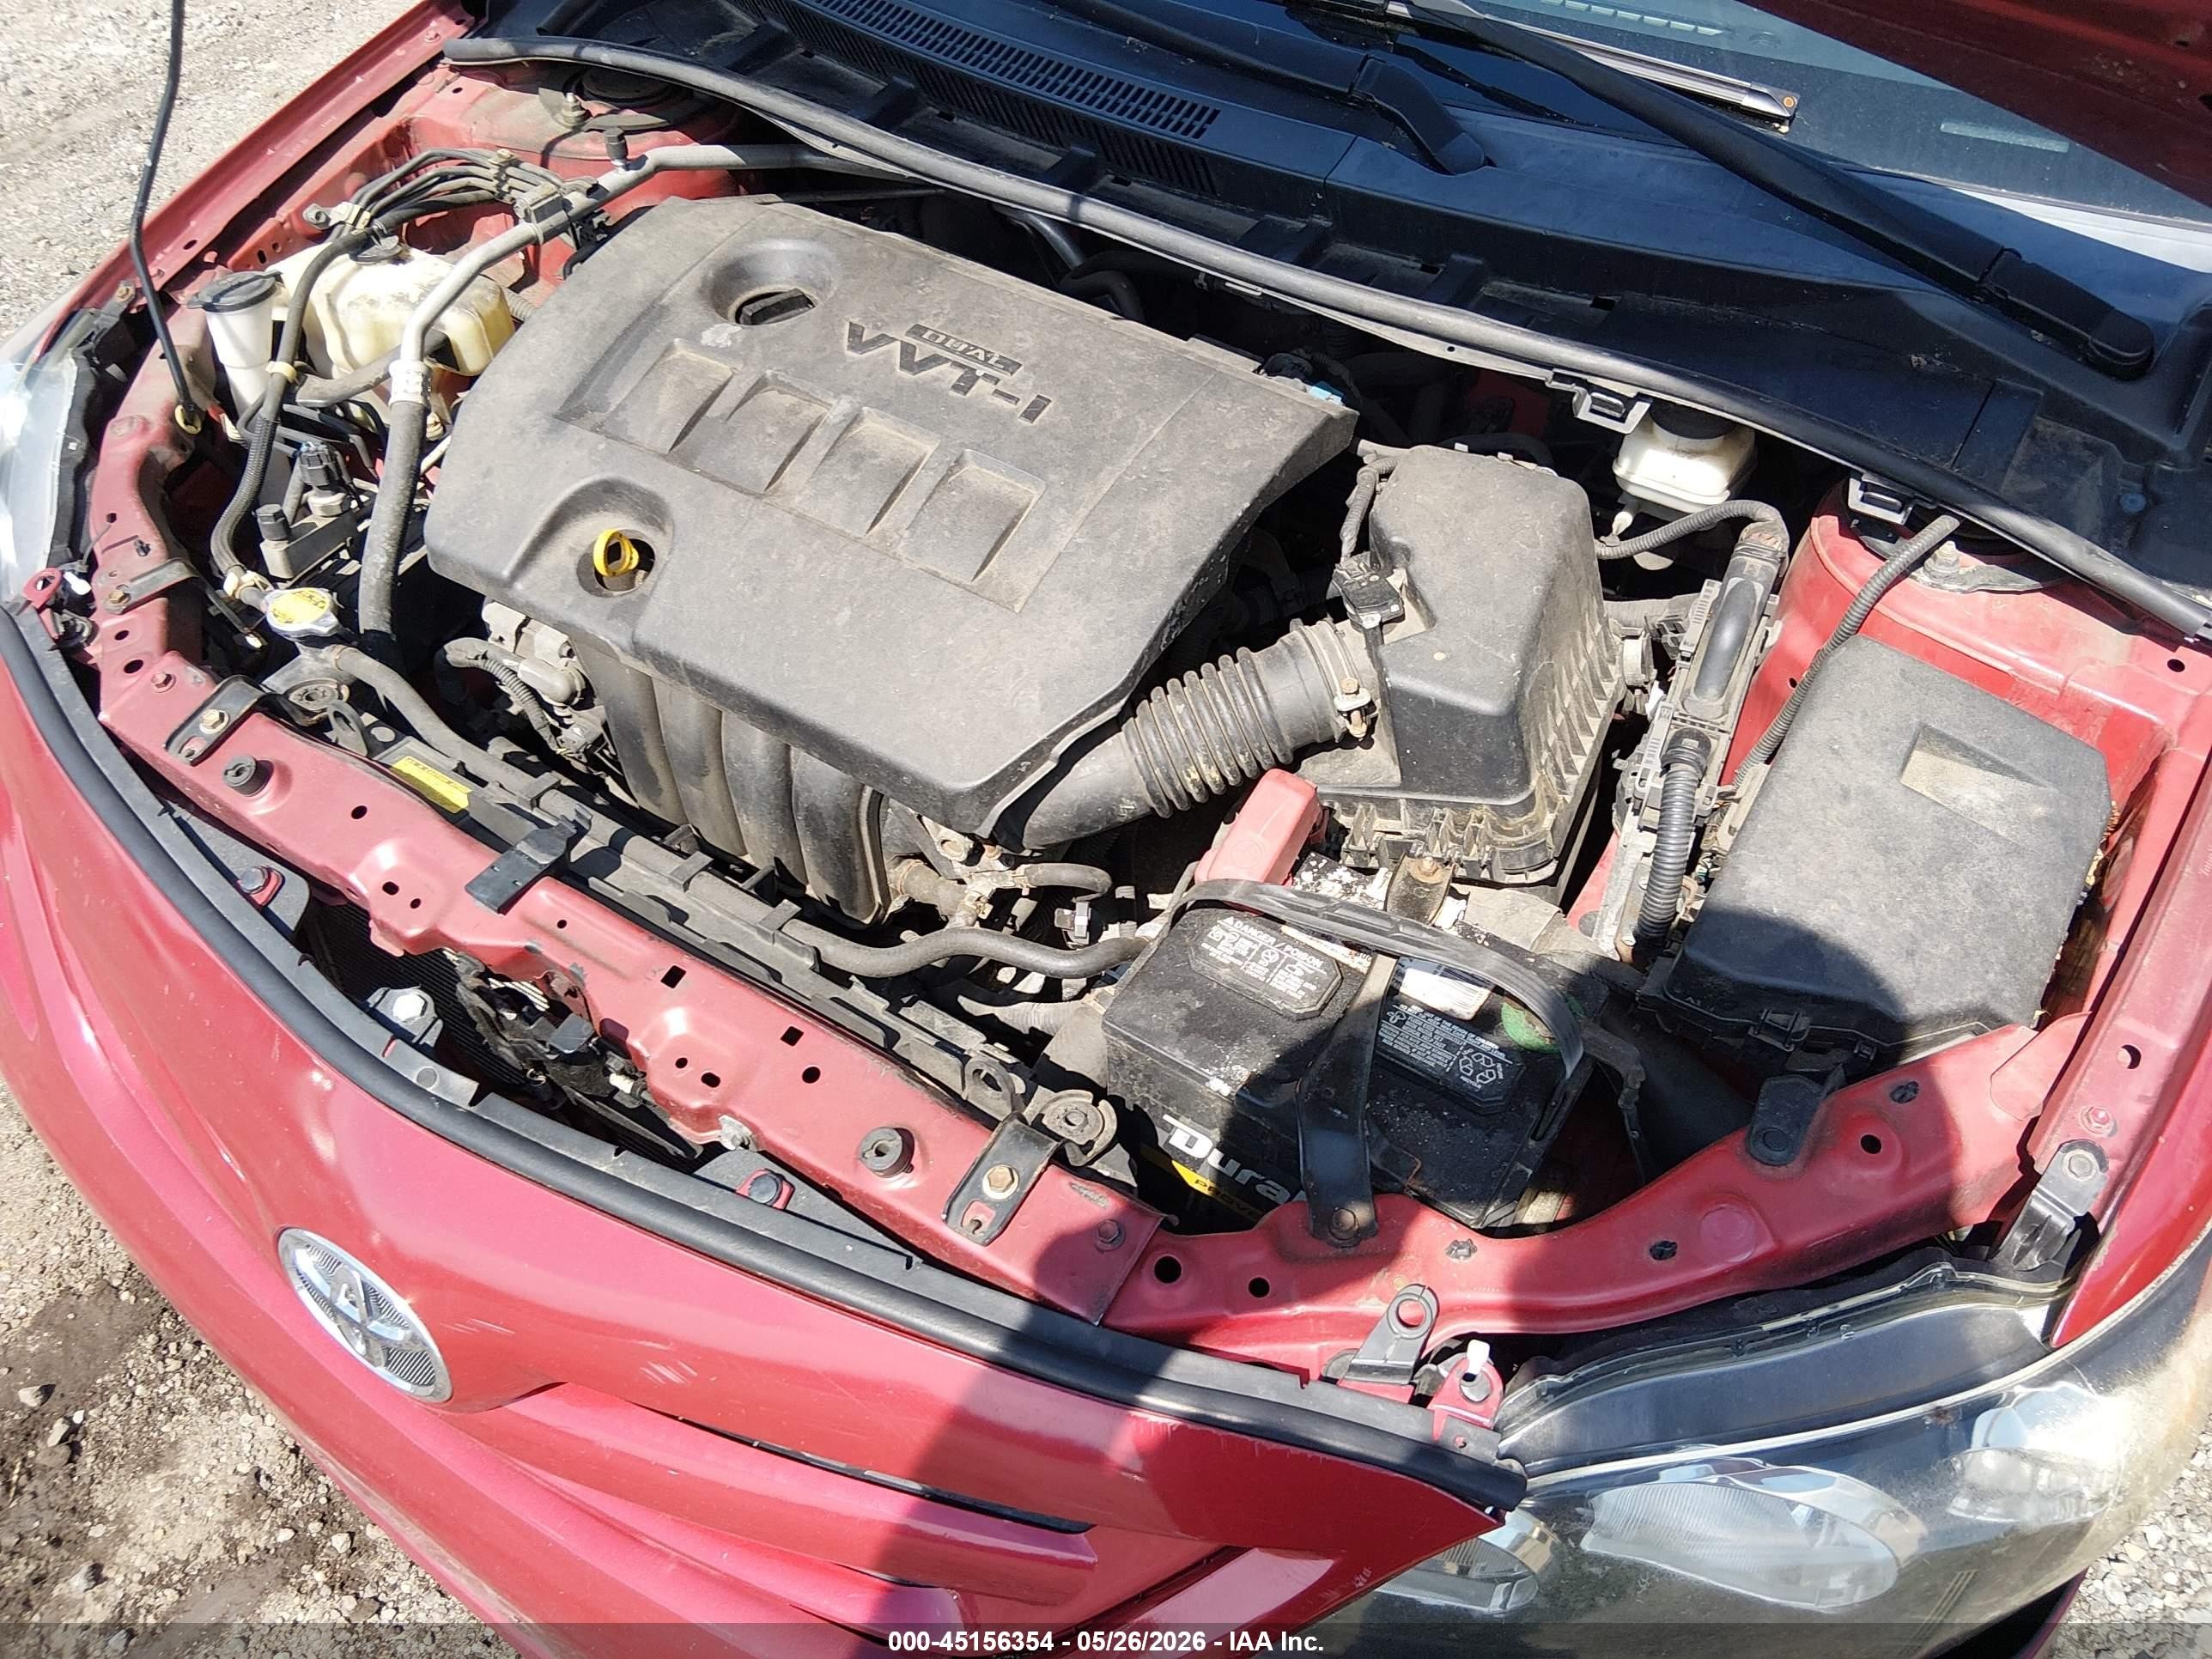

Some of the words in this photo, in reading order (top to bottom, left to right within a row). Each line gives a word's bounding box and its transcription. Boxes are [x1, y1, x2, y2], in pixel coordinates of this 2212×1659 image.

[920, 328, 1007, 370] DUAL
[1234, 920, 1277, 945] DANGER
[1283, 945, 1323, 969] POISON
[1451, 1024, 1468, 1035] REACH
[1466, 1036, 1480, 1045] TIGHT
[1492, 1048, 1506, 1059] LEVEL
[1460, 1075, 1482, 1090] RECYCLE
[1162, 1113, 1307, 1204] Dura
